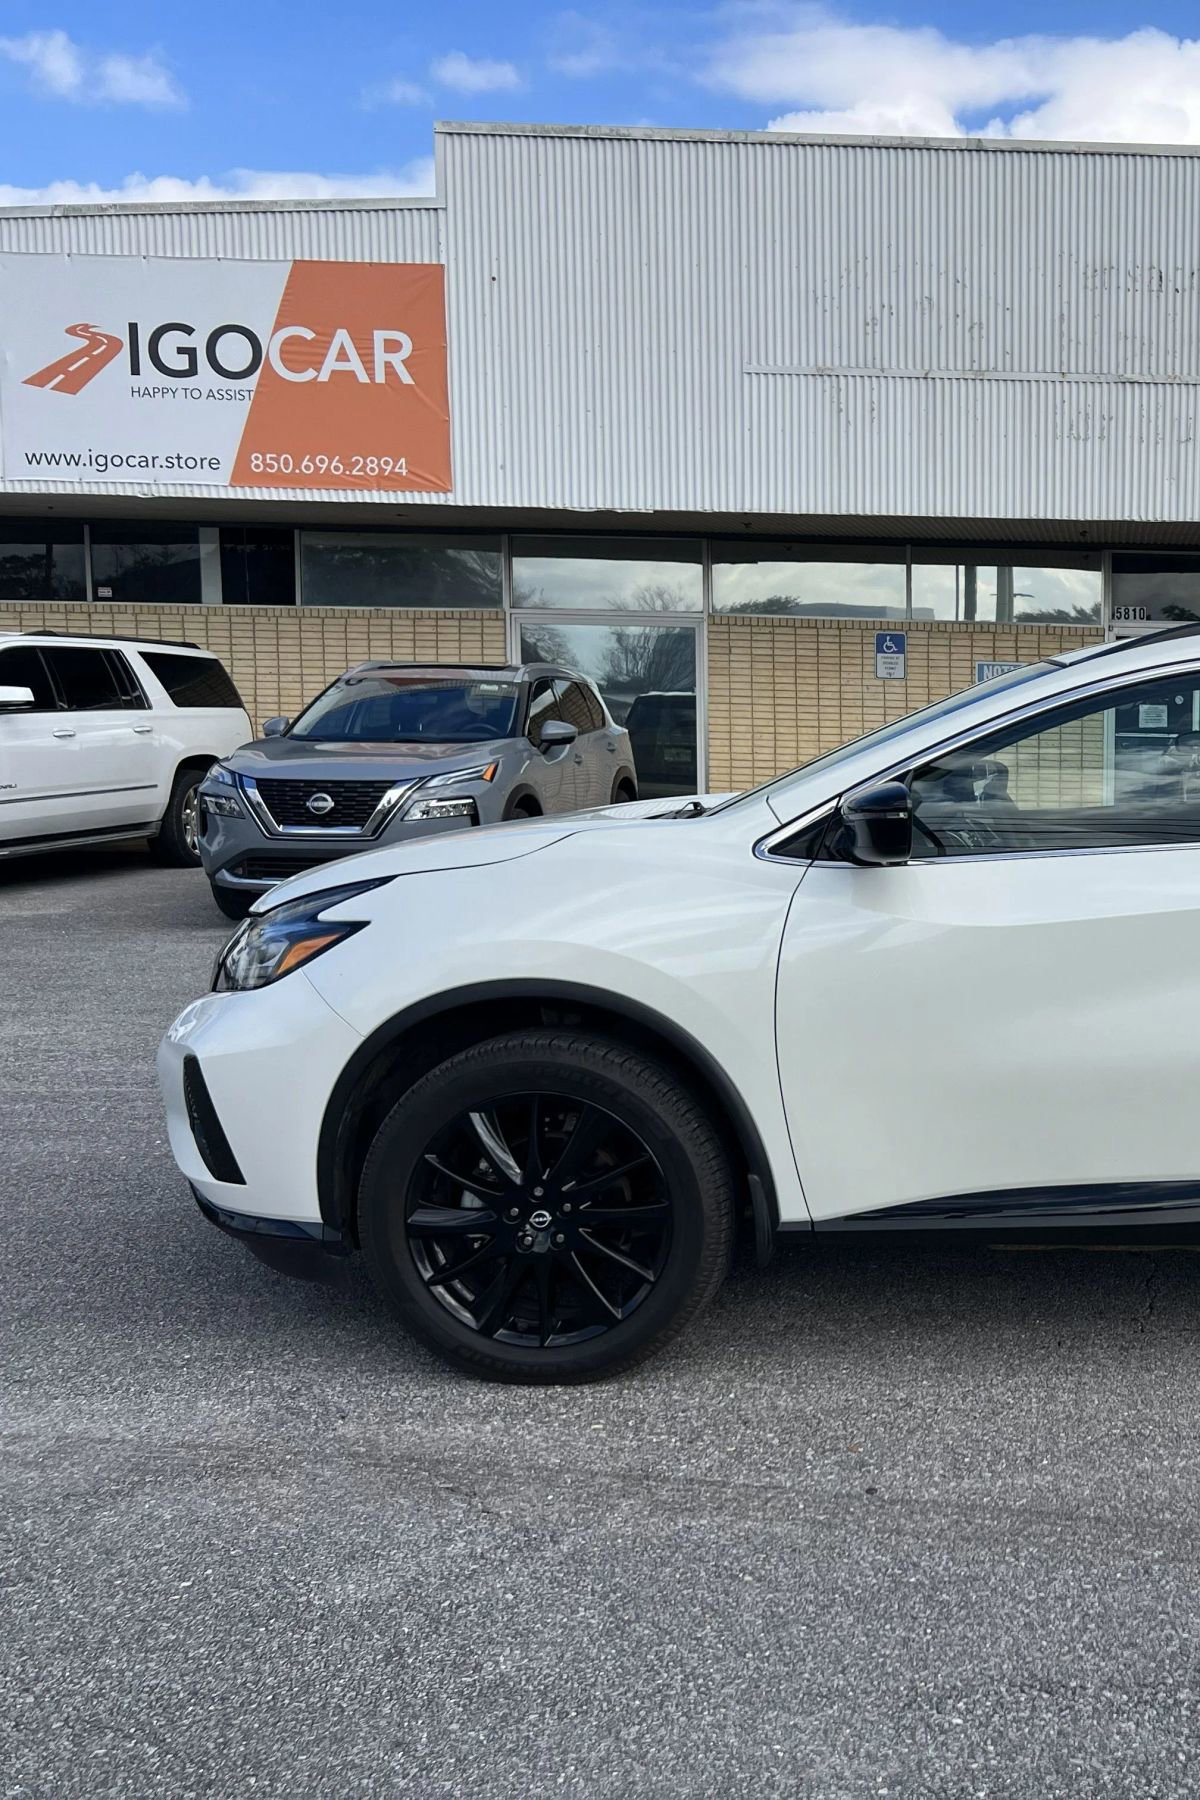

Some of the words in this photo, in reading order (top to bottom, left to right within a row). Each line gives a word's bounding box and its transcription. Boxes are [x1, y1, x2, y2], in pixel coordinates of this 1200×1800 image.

[131, 386, 177, 400] HAPPY
[181, 387, 203, 401] TO
[206, 388, 255, 402] ASSIST
[25, 448, 221, 473] www.igocar.store
[251, 453, 408, 476] 850.696.2894
[1115, 607, 1145, 620] 5810
[983, 664, 1018, 681] NOT
